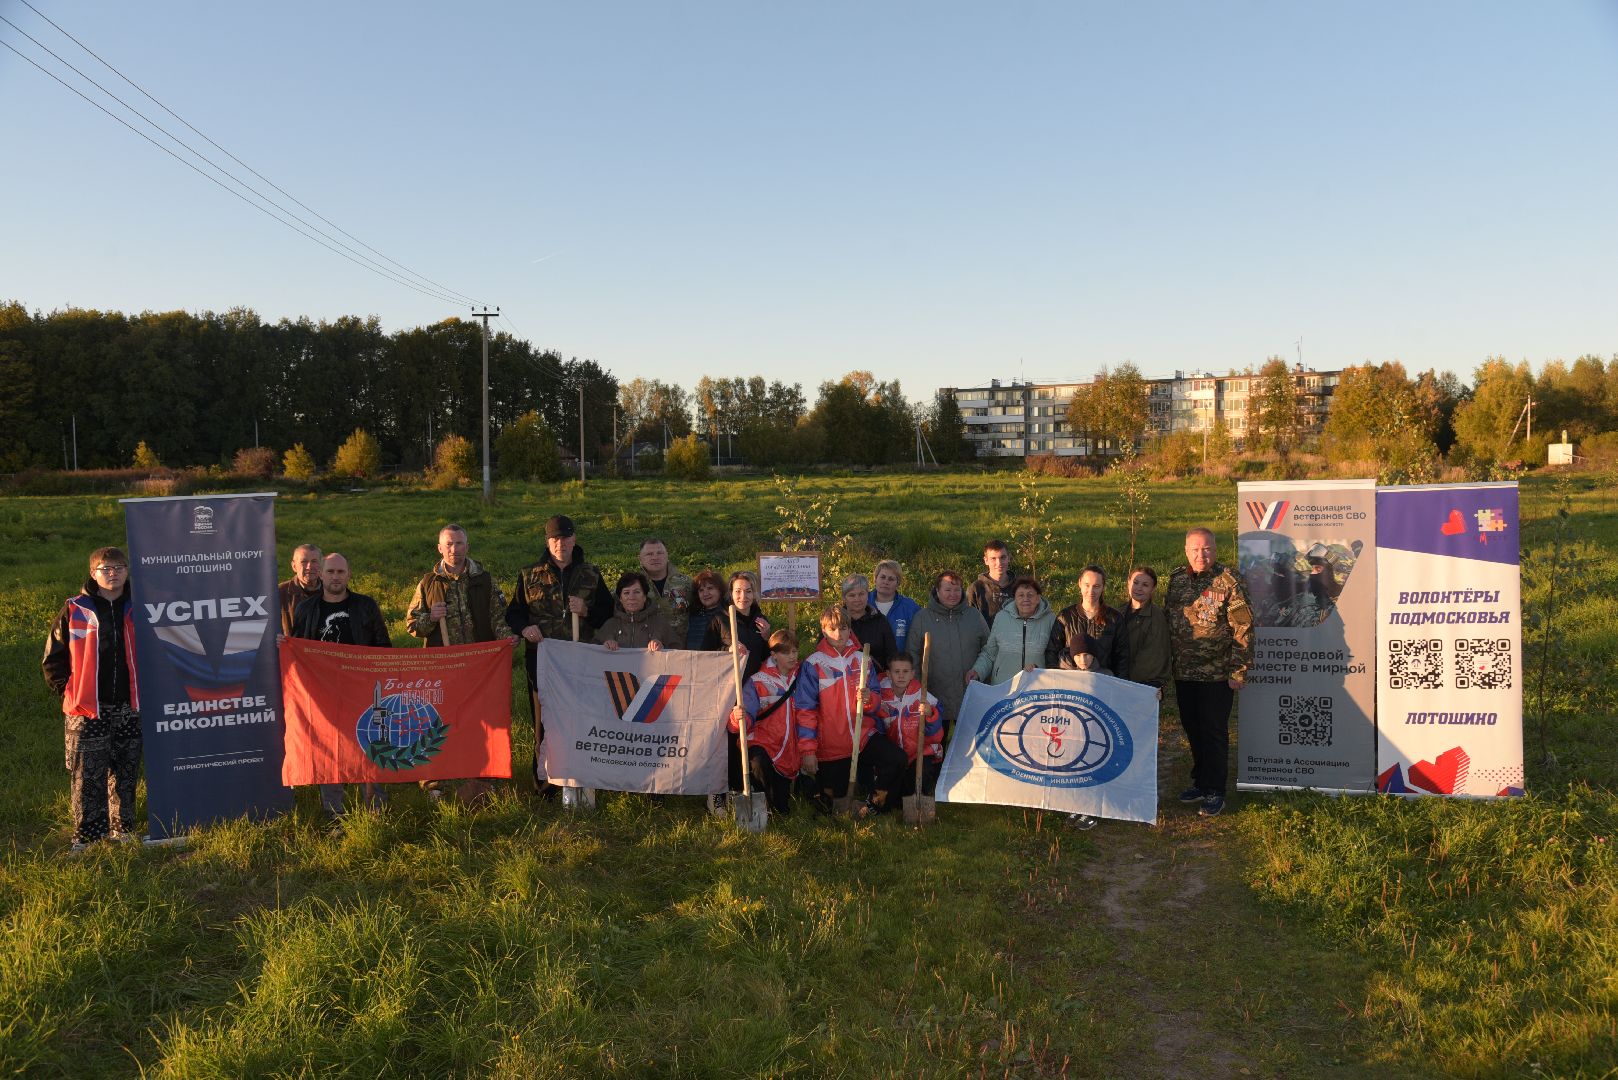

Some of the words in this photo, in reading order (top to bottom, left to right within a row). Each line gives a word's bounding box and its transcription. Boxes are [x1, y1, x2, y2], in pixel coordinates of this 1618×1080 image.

[1294, 513, 1344, 521] ветеранов
[142, 550, 232, 564] МУНИЦИПАЛЬНЫЙ
[234, 550, 264, 560] ОКРУГ
[176, 562, 232, 574] ЛОТОШИНО
[1398, 588, 1500, 605] ВОЛОНТЁРЫ
[144, 595, 269, 624] УСПЕХ
[1389, 611, 1510, 626] ПОДМОСКОВЬЯ
[1254, 638, 1298, 647] месте
[1268, 650, 1344, 662] передовой
[1301, 664, 1308, 672] в
[1312, 664, 1366, 675] мирной
[384, 678, 442, 690] Боевое
[1247, 676, 1292, 684] жизни
[163, 696, 266, 716] ЕДИНСТВЕ
[156, 708, 276, 733] ПОКОЛЕНИЙ
[1405, 712, 1497, 725] ЛОТОШИНО
[588, 726, 679, 744] Ассоциация
[575, 740, 652, 757] ветеранов
[656, 746, 688, 758] СВО
[590, 756, 637, 767] Московской
[638, 760, 670, 769] области
[1248, 756, 1284, 764] Вступай
[1294, 758, 1350, 768] Ассоциацию
[1011, 769, 1043, 783] ВОЕННЫХ
